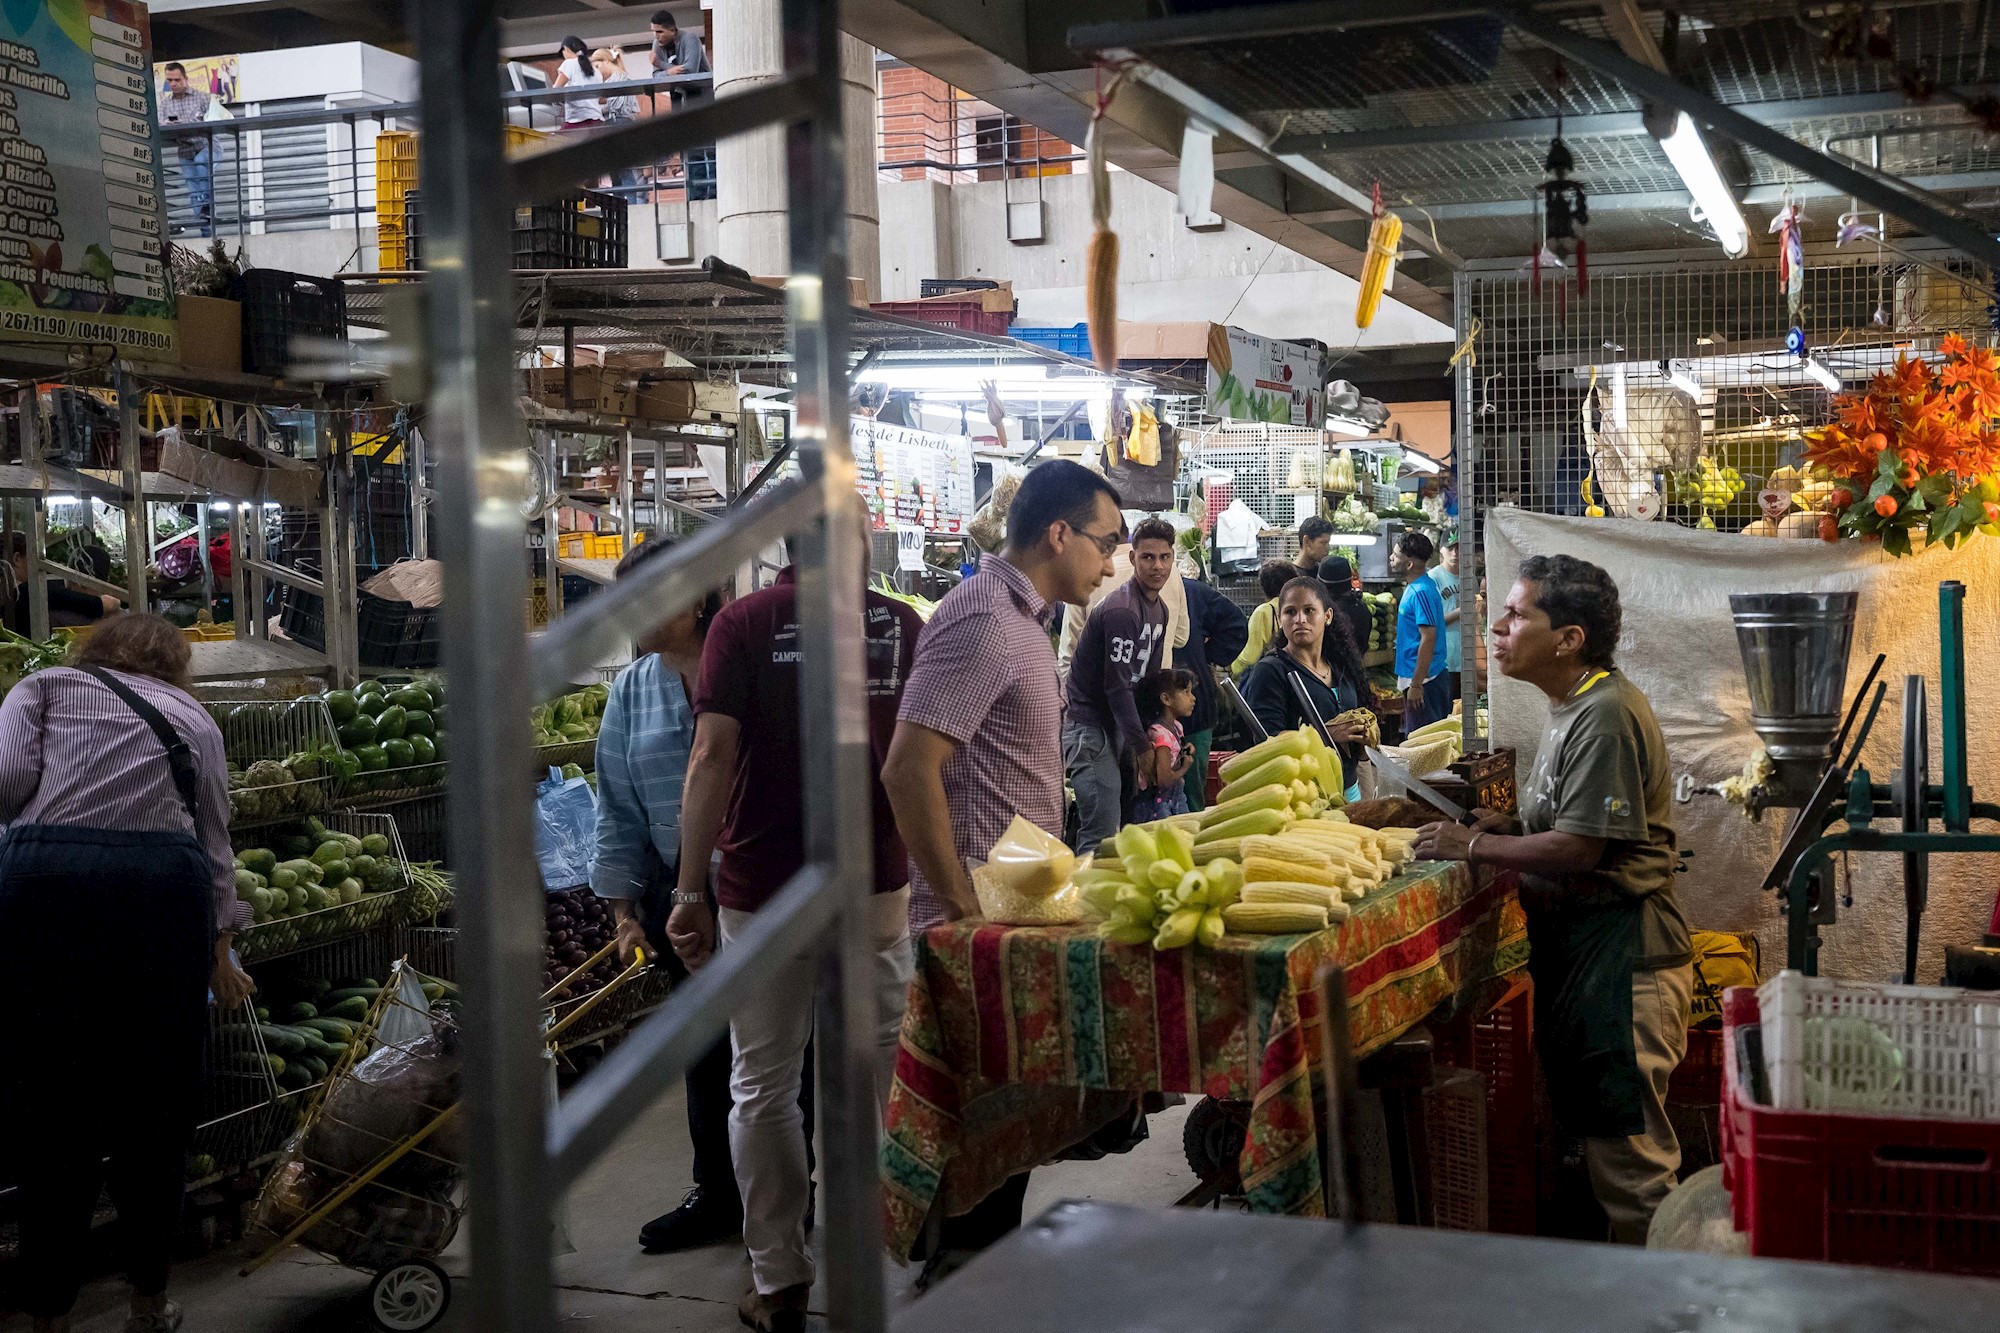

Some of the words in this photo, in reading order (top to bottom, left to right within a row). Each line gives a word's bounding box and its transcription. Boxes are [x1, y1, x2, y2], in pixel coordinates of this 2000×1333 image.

[0, 41, 38, 66] nces.
[9, 65, 69, 98] Amarillo.
[3, 140, 46, 163] chino.
[6, 163, 54, 189] Rizado.
[7, 187, 57, 214] Cherry.
[9, 211, 27, 231] de
[29, 220, 62, 240] palo.
[0, 240, 31, 258] que.
[0, 263, 37, 284] orias
[41, 267, 109, 295] Pequeñas.
[5, 312, 66, 335] 267.11.90
[69, 320, 75, 337] /
[78, 322, 118, 342] (0414)
[876, 427, 893, 441] de
[1109, 636, 1134, 664] 33
